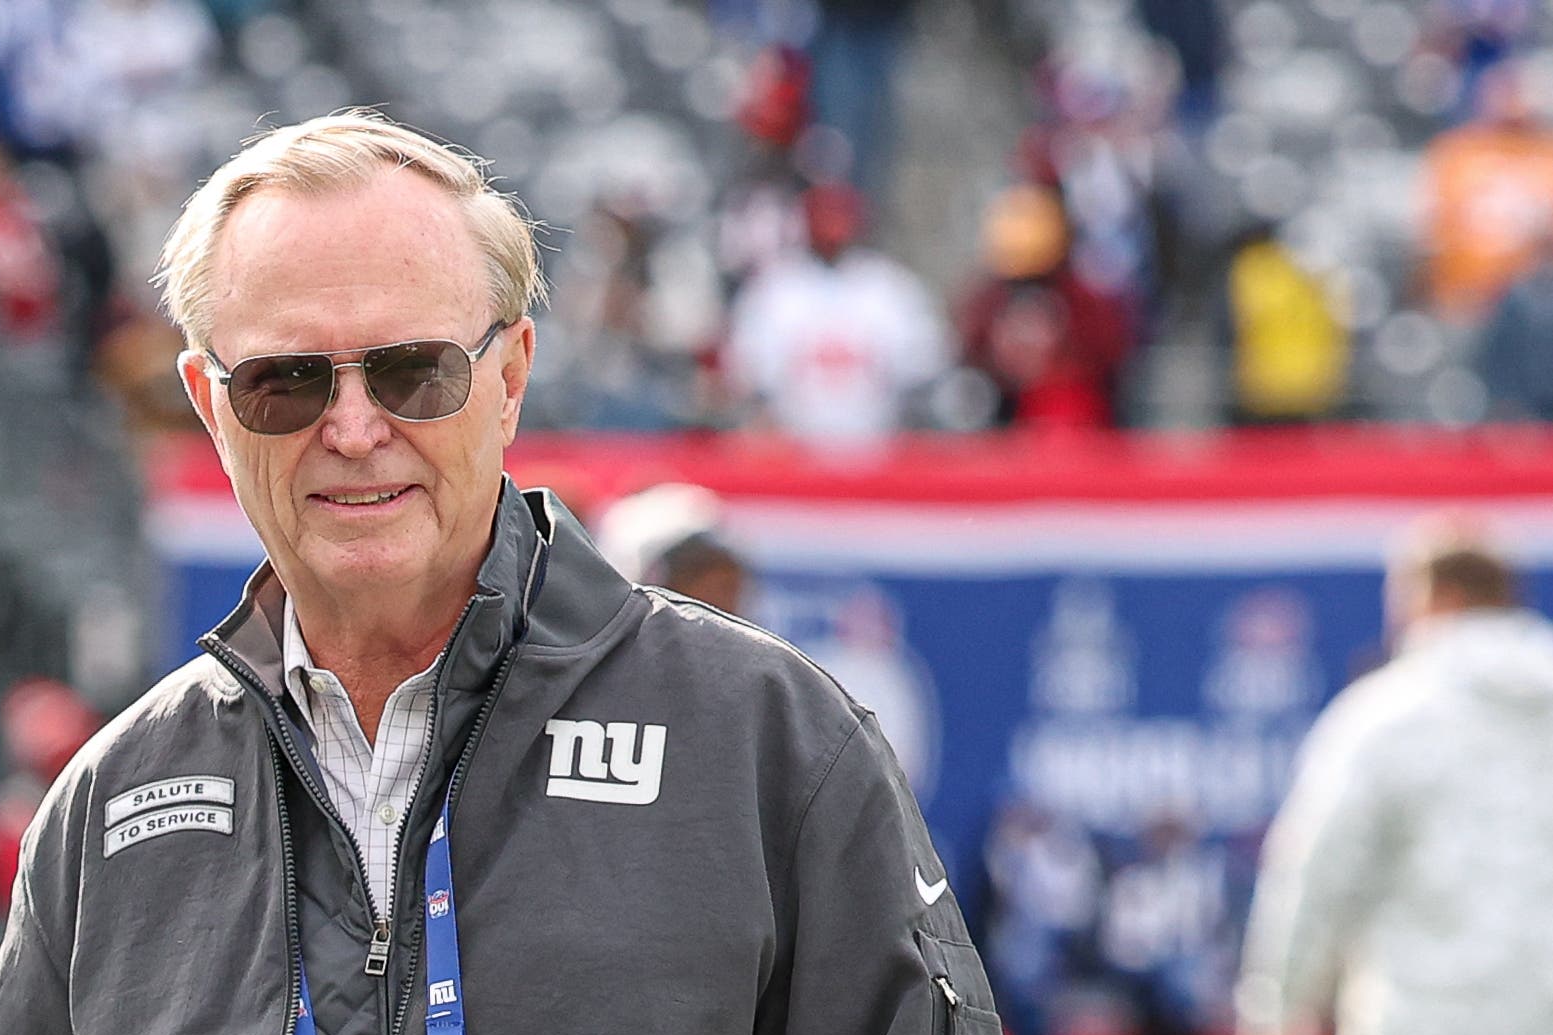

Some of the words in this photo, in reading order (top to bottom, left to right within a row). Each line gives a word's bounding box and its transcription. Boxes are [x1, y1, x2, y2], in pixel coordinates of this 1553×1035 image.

[133, 783, 204, 806] SALUTE
[118, 826, 140, 842] TO
[146, 812, 217, 831] SERVICE
